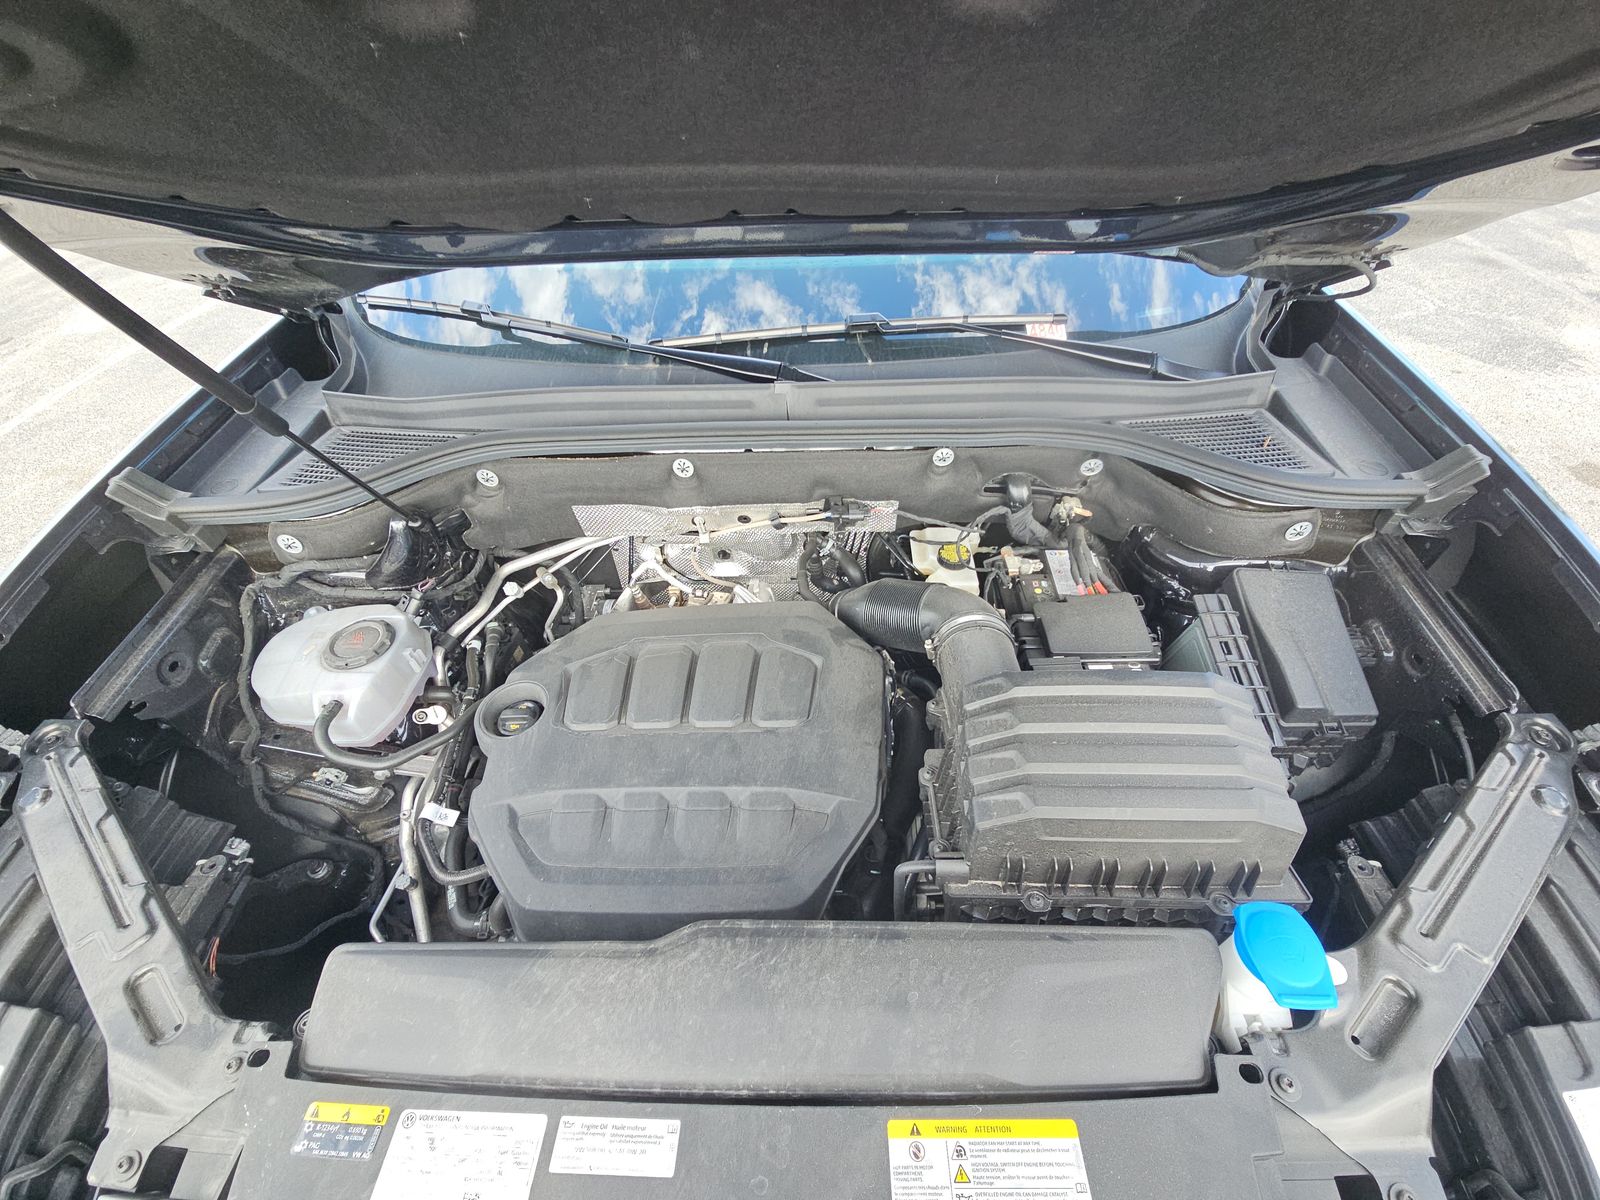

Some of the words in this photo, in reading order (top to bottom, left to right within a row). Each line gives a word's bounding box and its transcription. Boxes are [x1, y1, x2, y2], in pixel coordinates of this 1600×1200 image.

[419, 1114, 461, 1123] VOLKSWAGEN
[581, 1123, 599, 1131] Engine
[935, 1125, 968, 1134] WARNING
[974, 1125, 1012, 1134] ATTENTION
